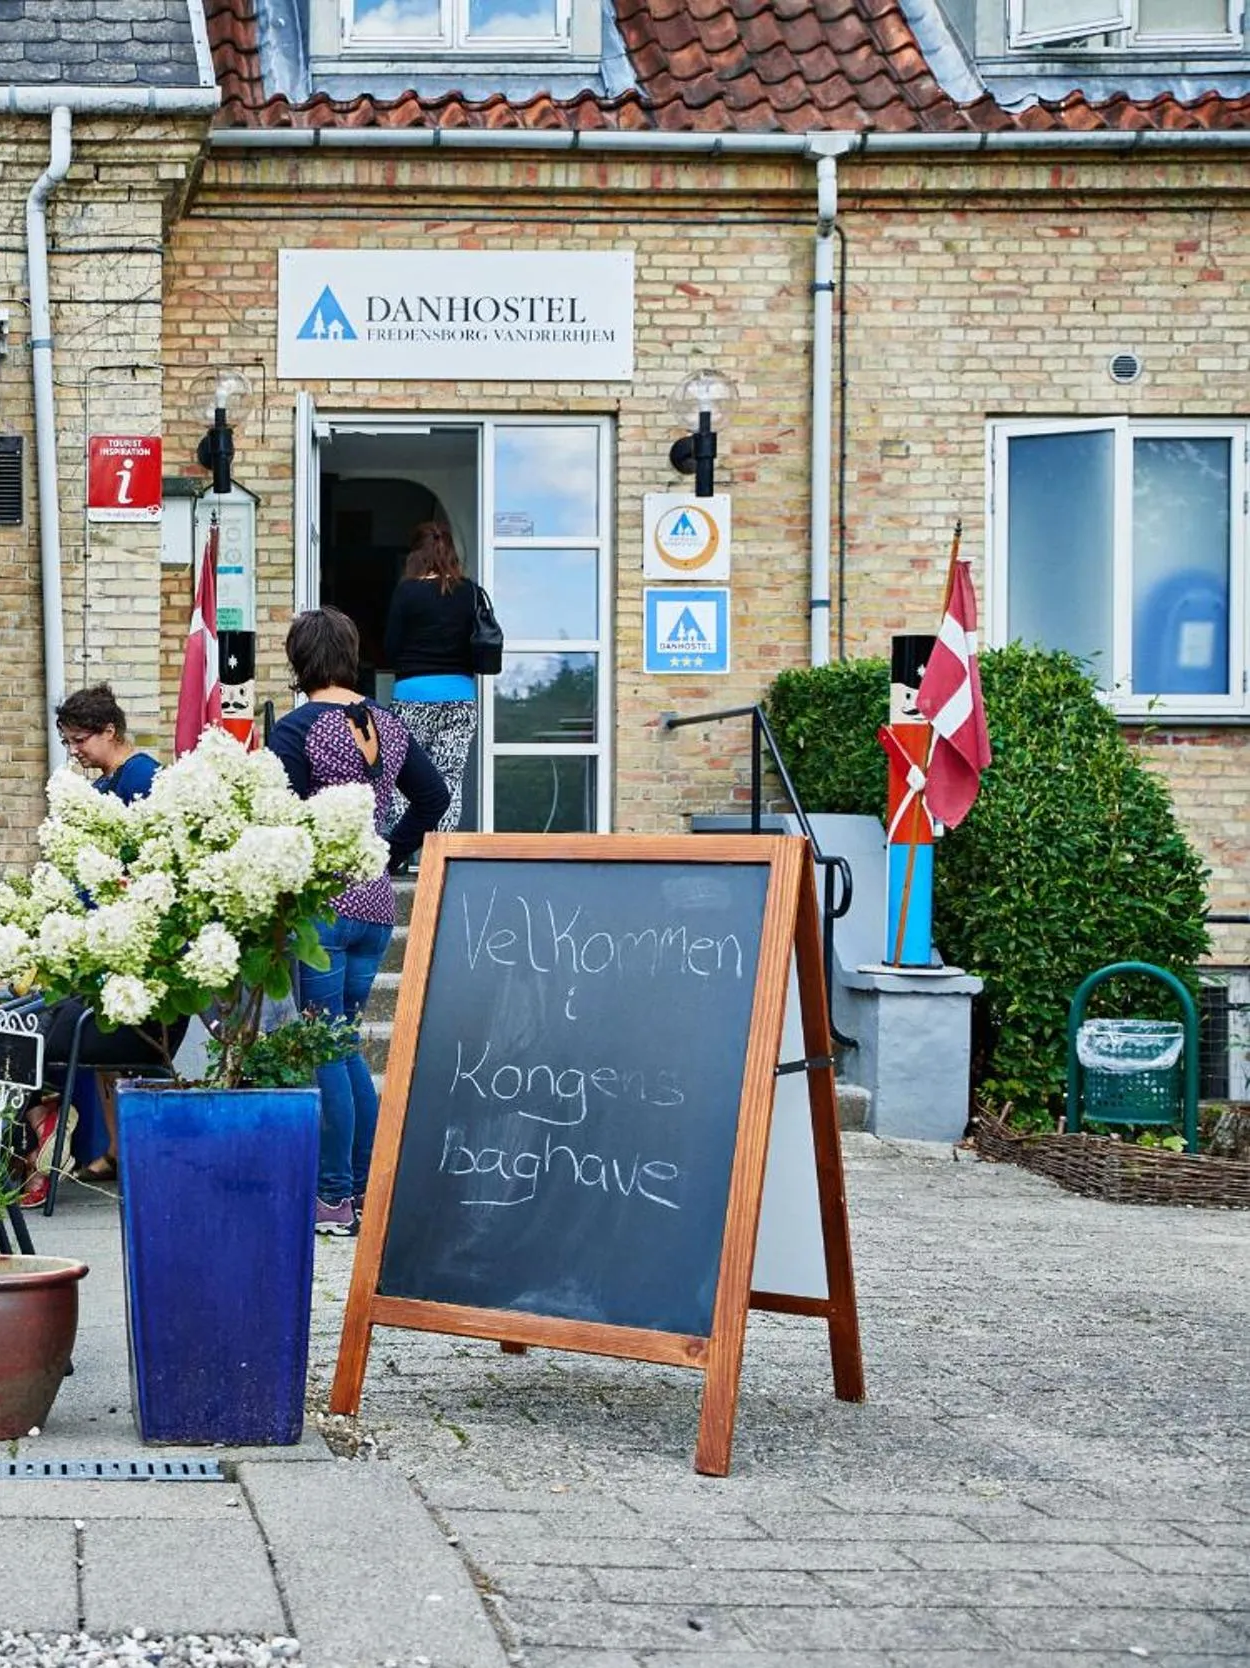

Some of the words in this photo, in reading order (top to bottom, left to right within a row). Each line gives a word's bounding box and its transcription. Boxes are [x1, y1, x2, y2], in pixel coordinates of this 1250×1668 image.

[366, 296, 586, 323] DANHOSTEL
[367, 329, 489, 341] FREDENSBORG
[493, 329, 615, 344] VANDRERHJEM
[108, 439, 143, 448] TOURIST
[99, 448, 151, 456] INSPIRATION
[659, 642, 712, 651] DANHOSTEL
[564, 987, 577, 1020] i
[450, 1040, 685, 1126] Kongens
